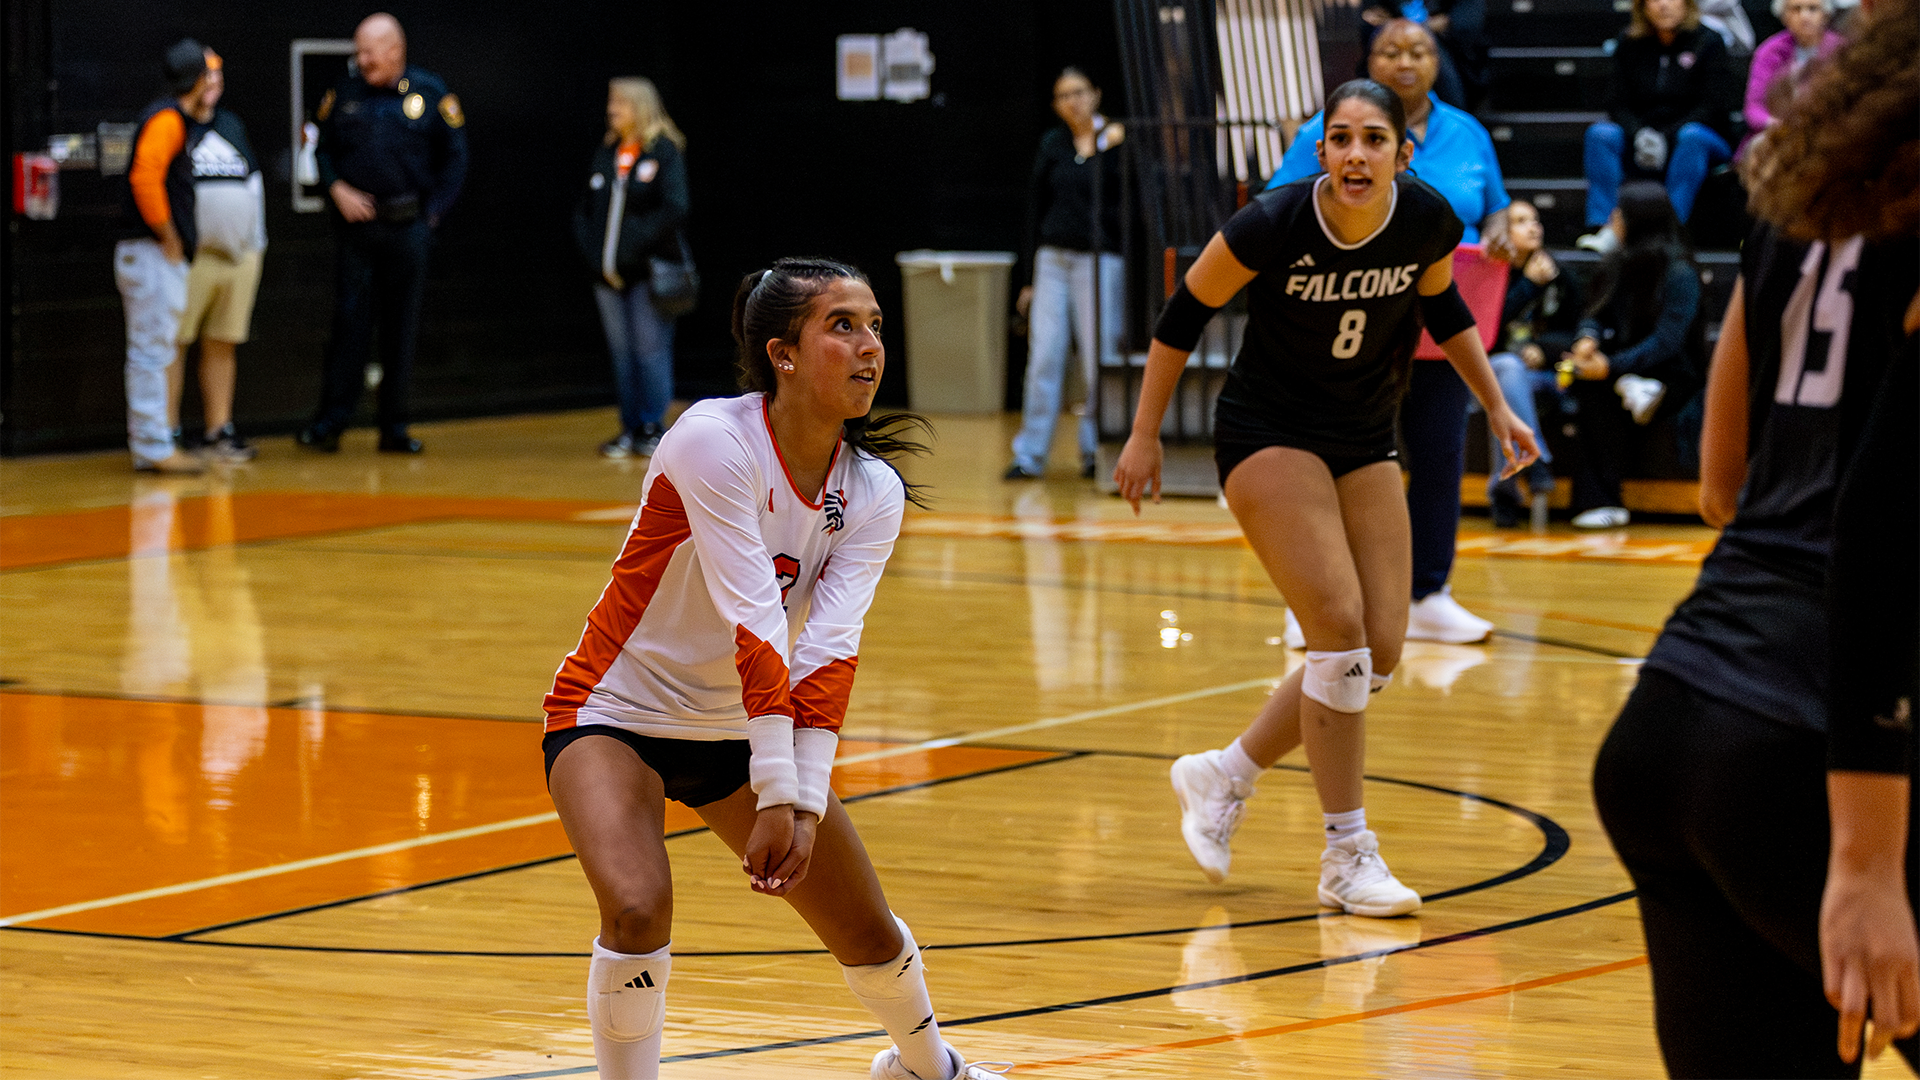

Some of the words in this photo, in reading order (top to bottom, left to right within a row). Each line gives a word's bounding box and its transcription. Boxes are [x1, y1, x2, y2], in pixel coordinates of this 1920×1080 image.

[1285, 263, 1419, 302] FALCONS
[1331, 309, 1367, 359] 8
[1774, 234, 1865, 408] 15
